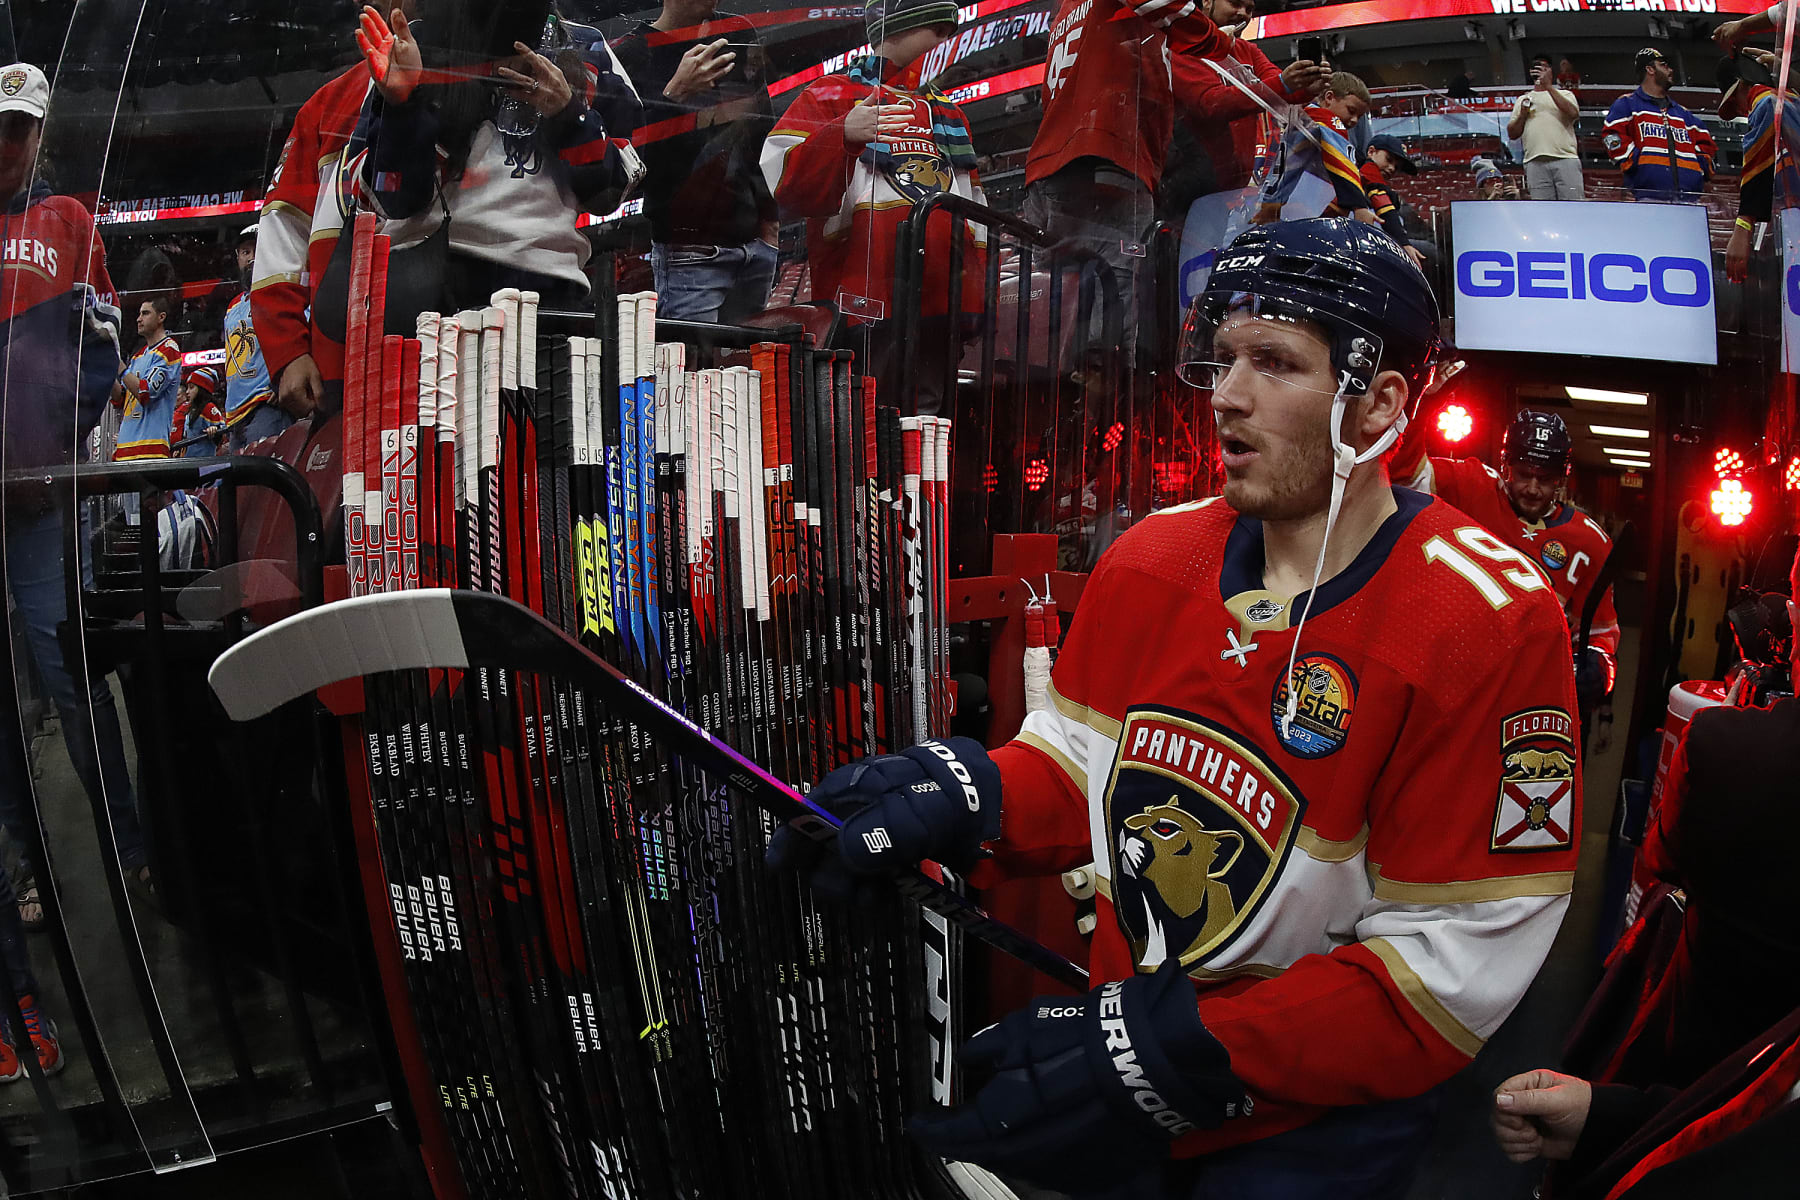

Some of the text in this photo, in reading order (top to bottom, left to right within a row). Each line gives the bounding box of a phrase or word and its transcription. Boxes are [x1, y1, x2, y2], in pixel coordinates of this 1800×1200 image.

[892, 142, 936, 154] ANTHER
[2, 238, 59, 278] HERS
[1215, 254, 1266, 272] CCM
[1456, 250, 1712, 308] GEICO
[405, 426, 415, 442] 6
[624, 398, 643, 614] NEXUS SYNC
[643, 393, 659, 606] NEXUS SYNC
[662, 491, 674, 594] SHERWOOD
[677, 488, 688, 591] SHERWOOD
[1422, 525, 1553, 612] 19
[1567, 553, 1590, 585] C
[480, 666, 490, 701] ENNETT
[499, 667, 508, 697] NNETT
[751, 659, 762, 719] LUOSTARINEN
[558, 692, 569, 730] REINHART
[574, 690, 585, 727] REINHART
[713, 692, 722, 729] COUSINS
[1511, 718, 1570, 737] FLORIDA
[368, 732, 383, 776] EKBLAD
[386, 734, 400, 777] EKBLAD
[401, 722, 415, 765] WHITEY
[418, 722, 432, 764] WHITEY
[439, 731, 449, 758] BUTCH
[457, 733, 467, 760] BUTCH
[526, 727, 537, 758] STAAL
[544, 725, 555, 756] STAAL
[1289, 727, 1312, 743] 2023
[1131, 725, 1274, 831] PANTHERS
[390, 882, 416, 961] BAUER
[407, 885, 433, 962] BAUER
[421, 875, 446, 952] BAUER
[438, 874, 462, 951] BAUER
[567, 995, 587, 1053] BAUER
[582, 992, 602, 1051] BAUER
[1101, 980, 1198, 1136] HERWOOD
